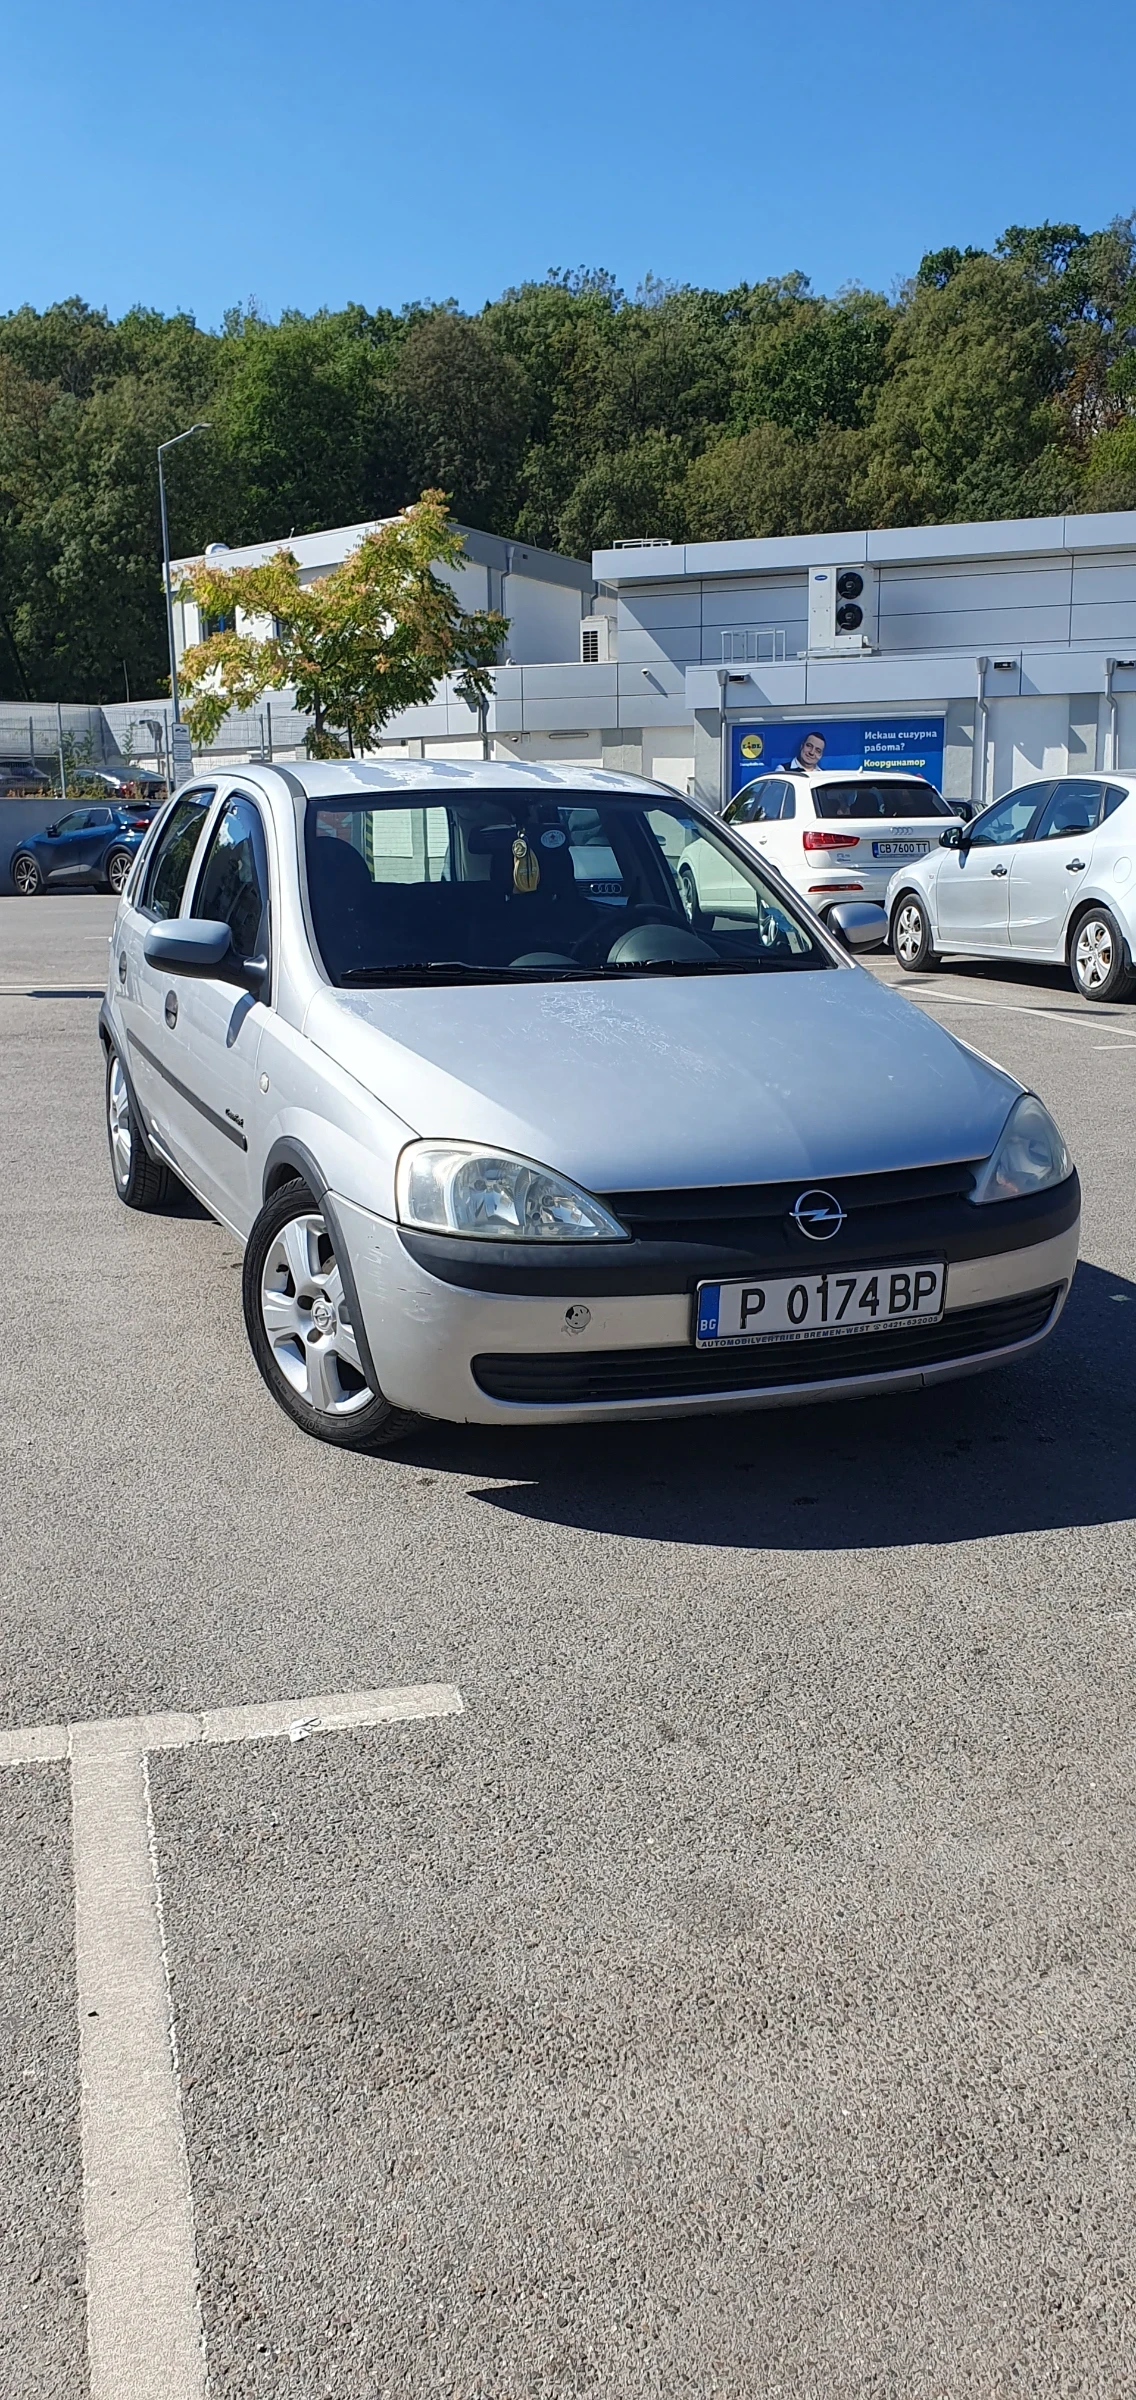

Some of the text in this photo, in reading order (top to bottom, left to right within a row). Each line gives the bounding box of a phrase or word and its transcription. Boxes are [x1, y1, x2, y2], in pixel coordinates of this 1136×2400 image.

[864, 730, 937, 740] Искаш сигурна
[864, 742, 905, 754] работа?
[864, 759, 926, 768] Координатор
[893, 843, 915, 853] 7600
[740, 1288, 766, 1329] P
[700, 1318, 717, 1332] BG
[701, 1333, 801, 1348] AUTOMOBILVERTRIEB
[803, 1325, 870, 1339] BREMEN-WEST
